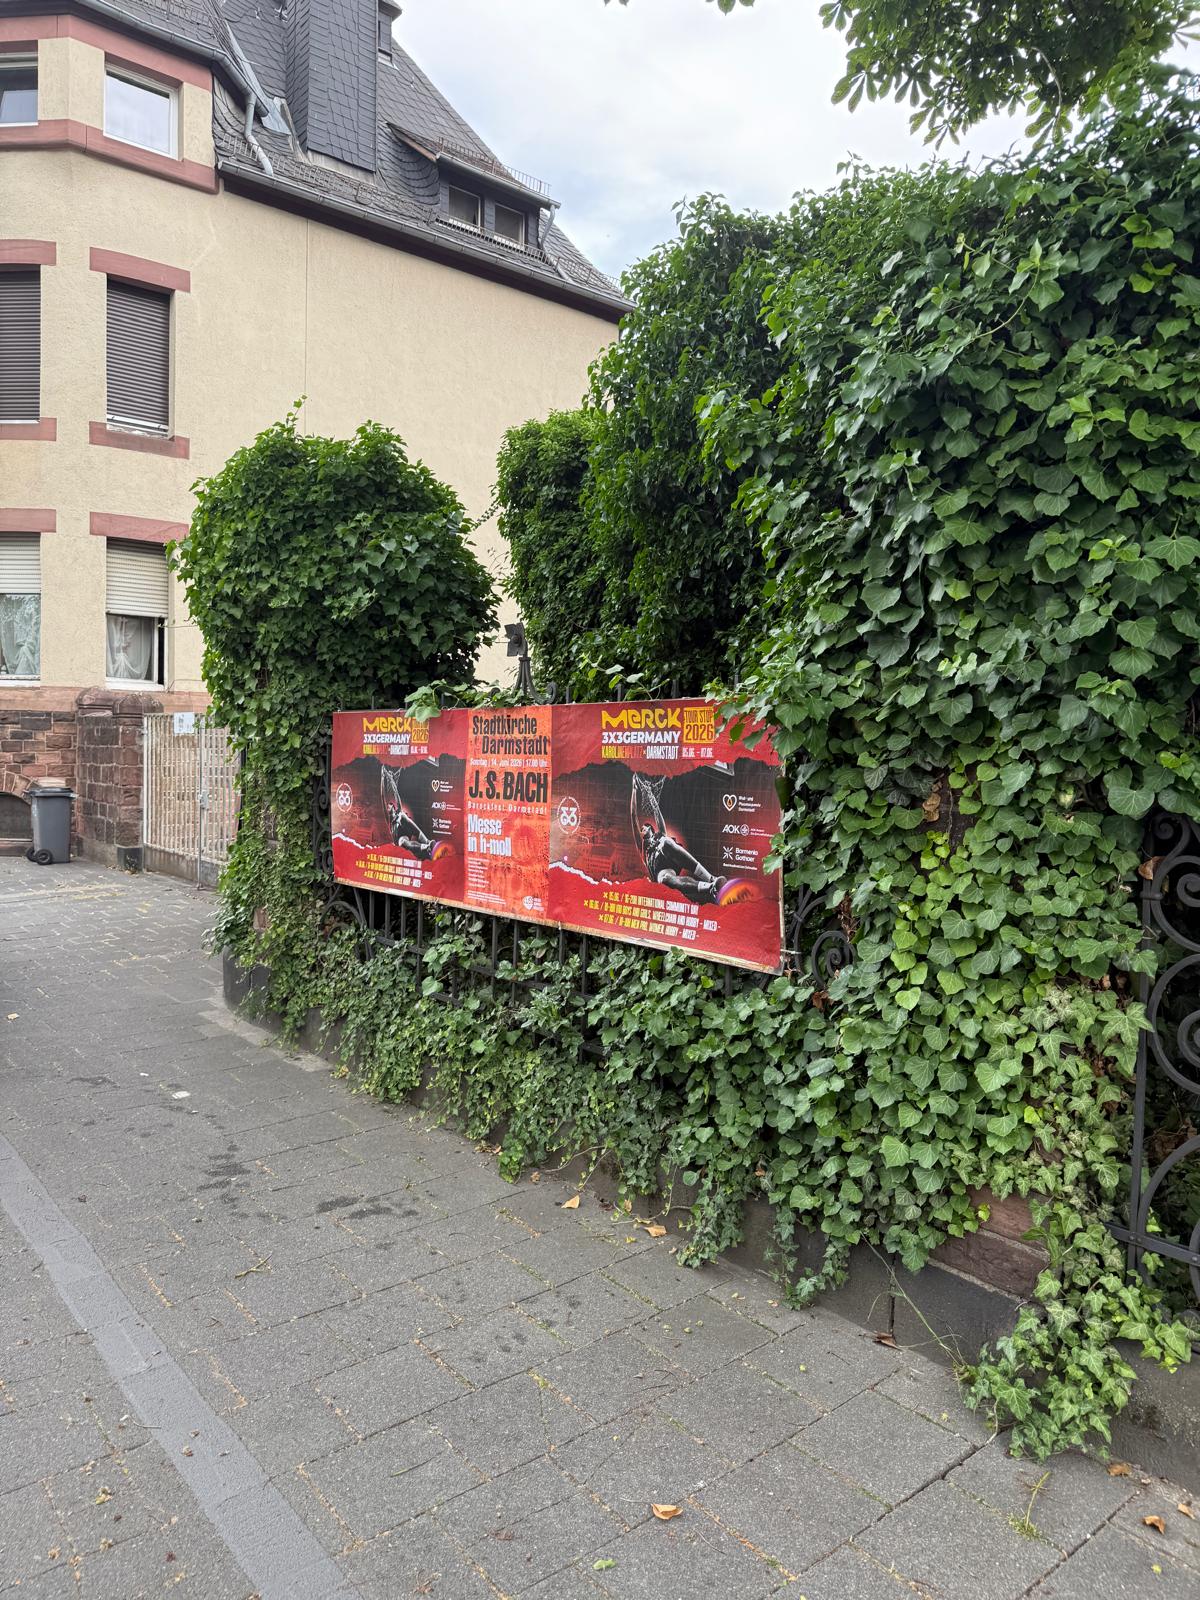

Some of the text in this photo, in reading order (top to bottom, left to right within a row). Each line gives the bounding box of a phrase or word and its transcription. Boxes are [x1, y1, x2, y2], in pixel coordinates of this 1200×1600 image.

[362, 716, 411, 733] MERCK
[472, 714, 537, 735] Stadtkirche
[601, 707, 681, 729] MERCK
[685, 724, 713, 741] 2026
[482, 735, 548, 755] Darmstadt
[646, 745, 679, 759] DARMSTADT
[503, 771, 548, 803] BACH
[508, 803, 547, 815] Darmstadt
[467, 813, 502, 836] Messe
[722, 824, 740, 834] AOK
[467, 832, 512, 857] in h-moll
